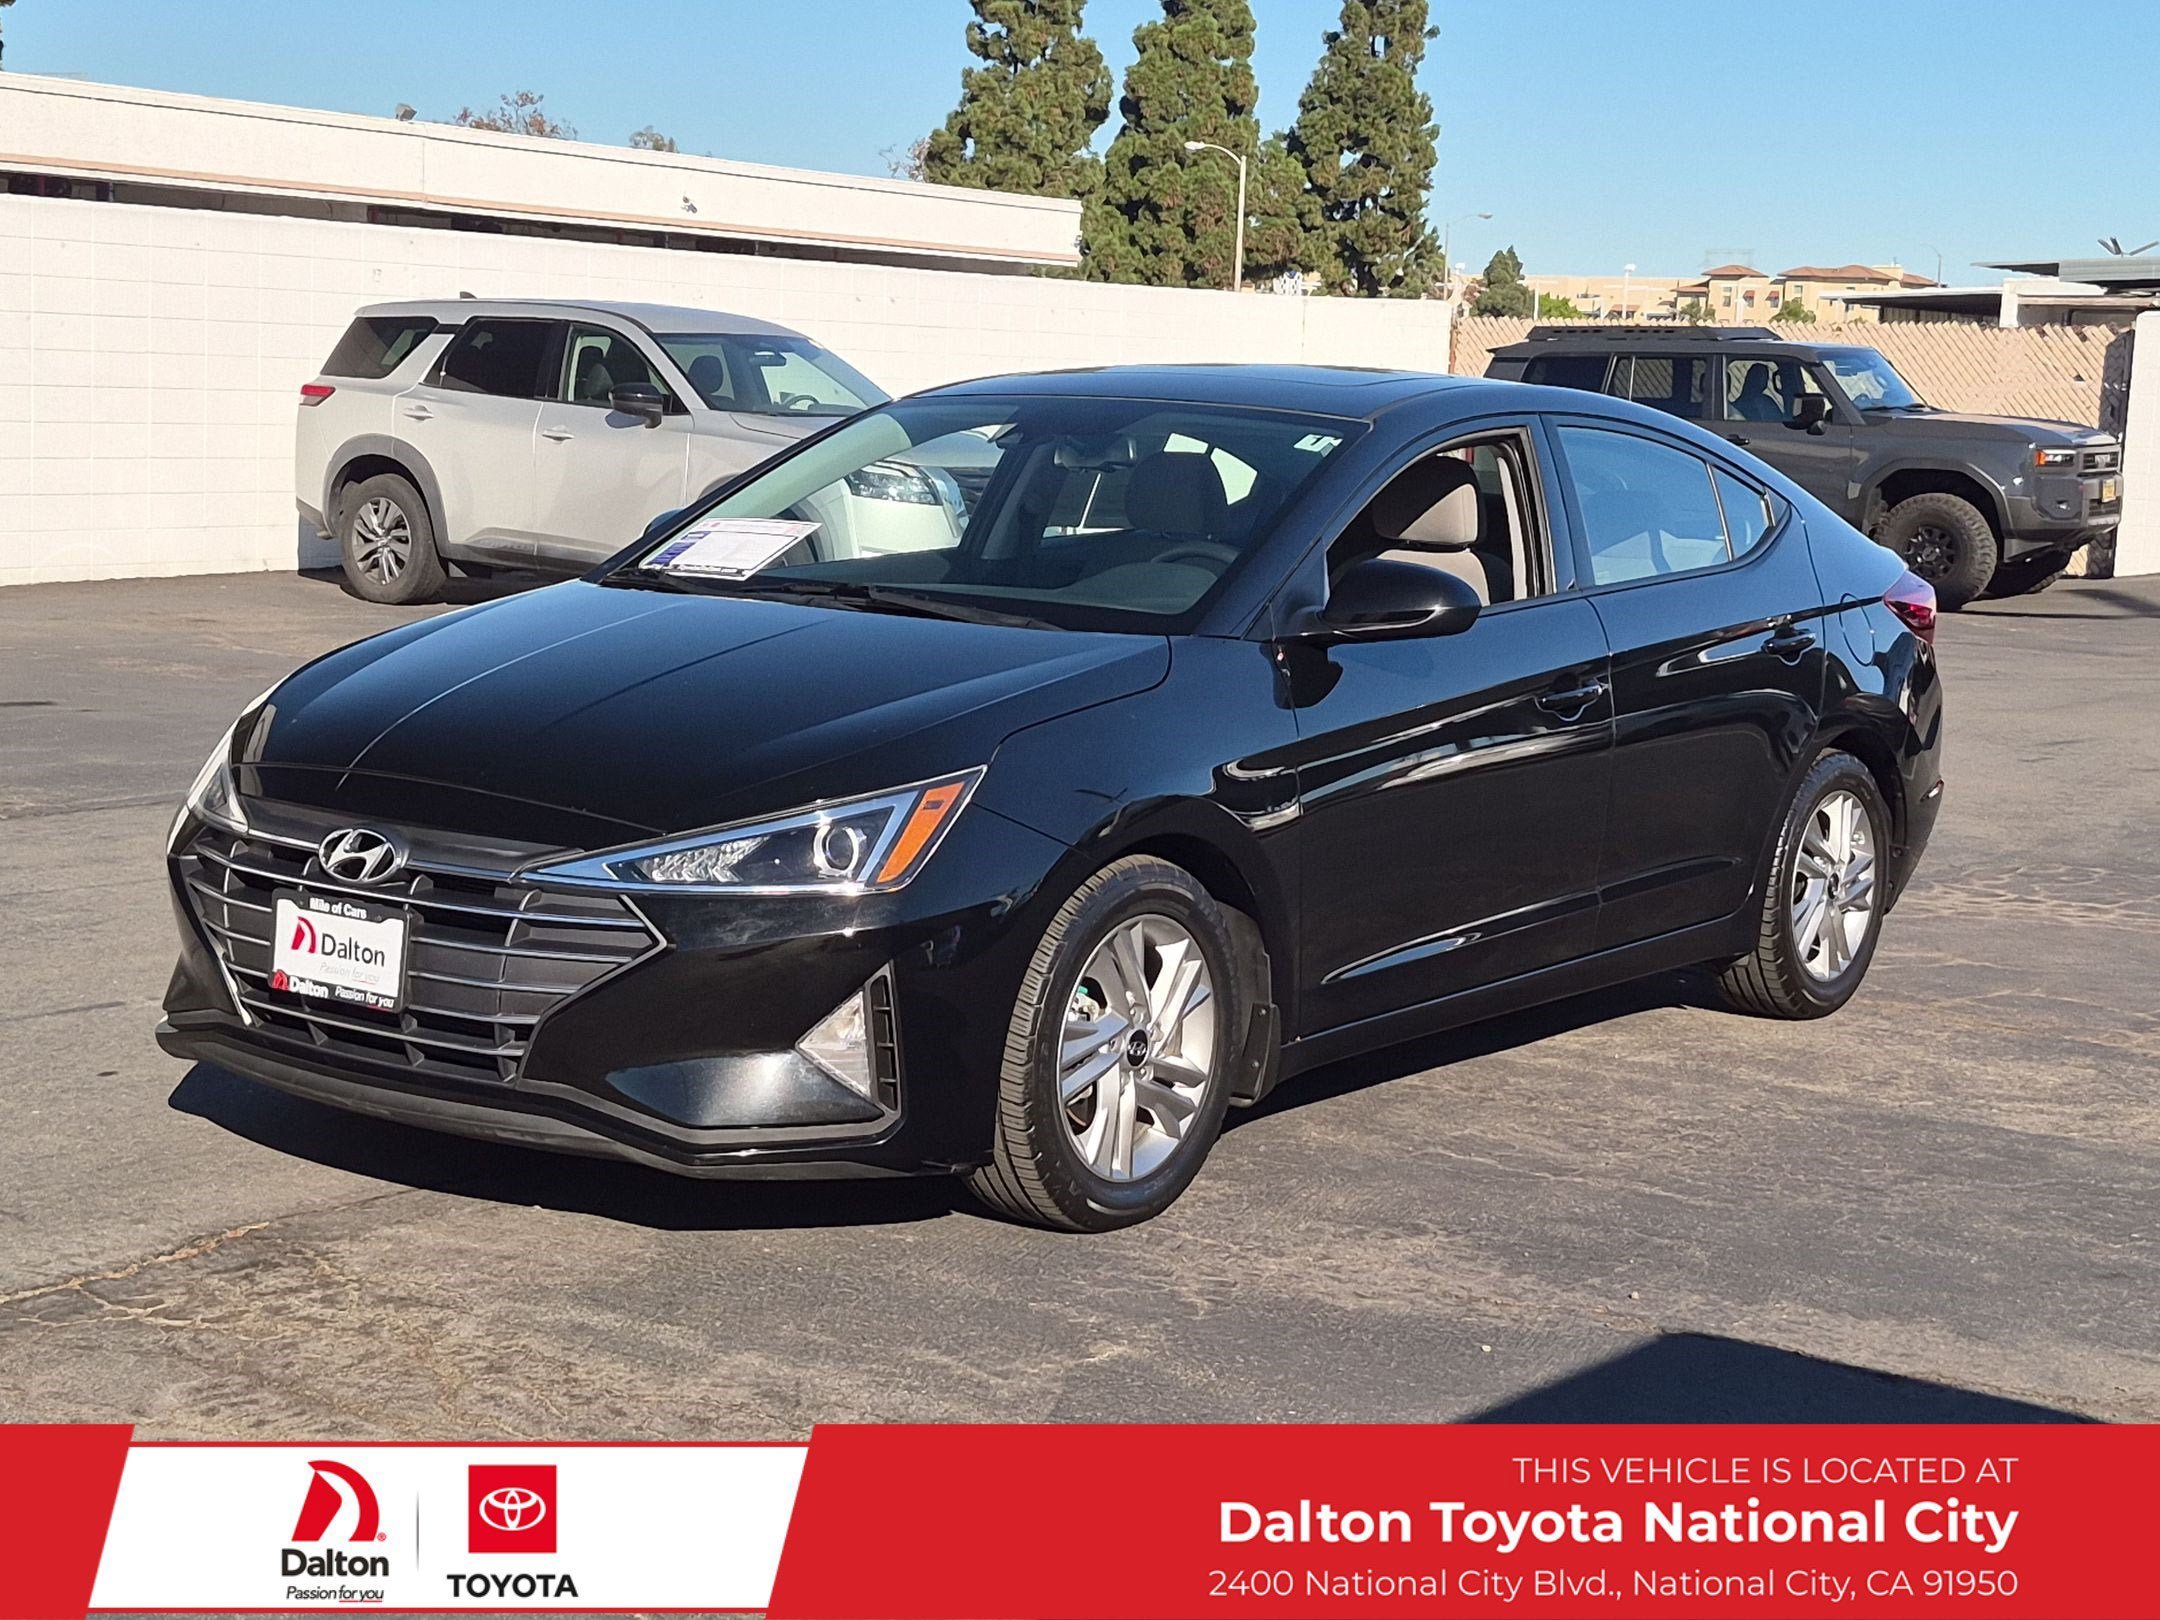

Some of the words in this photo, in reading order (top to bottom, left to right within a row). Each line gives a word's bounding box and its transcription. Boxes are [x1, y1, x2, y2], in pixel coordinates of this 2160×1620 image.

[310, 897, 330, 913] Mile
[331, 902, 342, 914] of
[343, 903, 367, 919] Cars
[321, 932, 385, 967] Dalton
[319, 962, 352, 978] Passion
[352, 967, 365, 979] for
[289, 975, 329, 999] Dalton
[335, 985, 365, 1002] Passion
[365, 992, 378, 1005] for
[377, 996, 394, 1009] you
